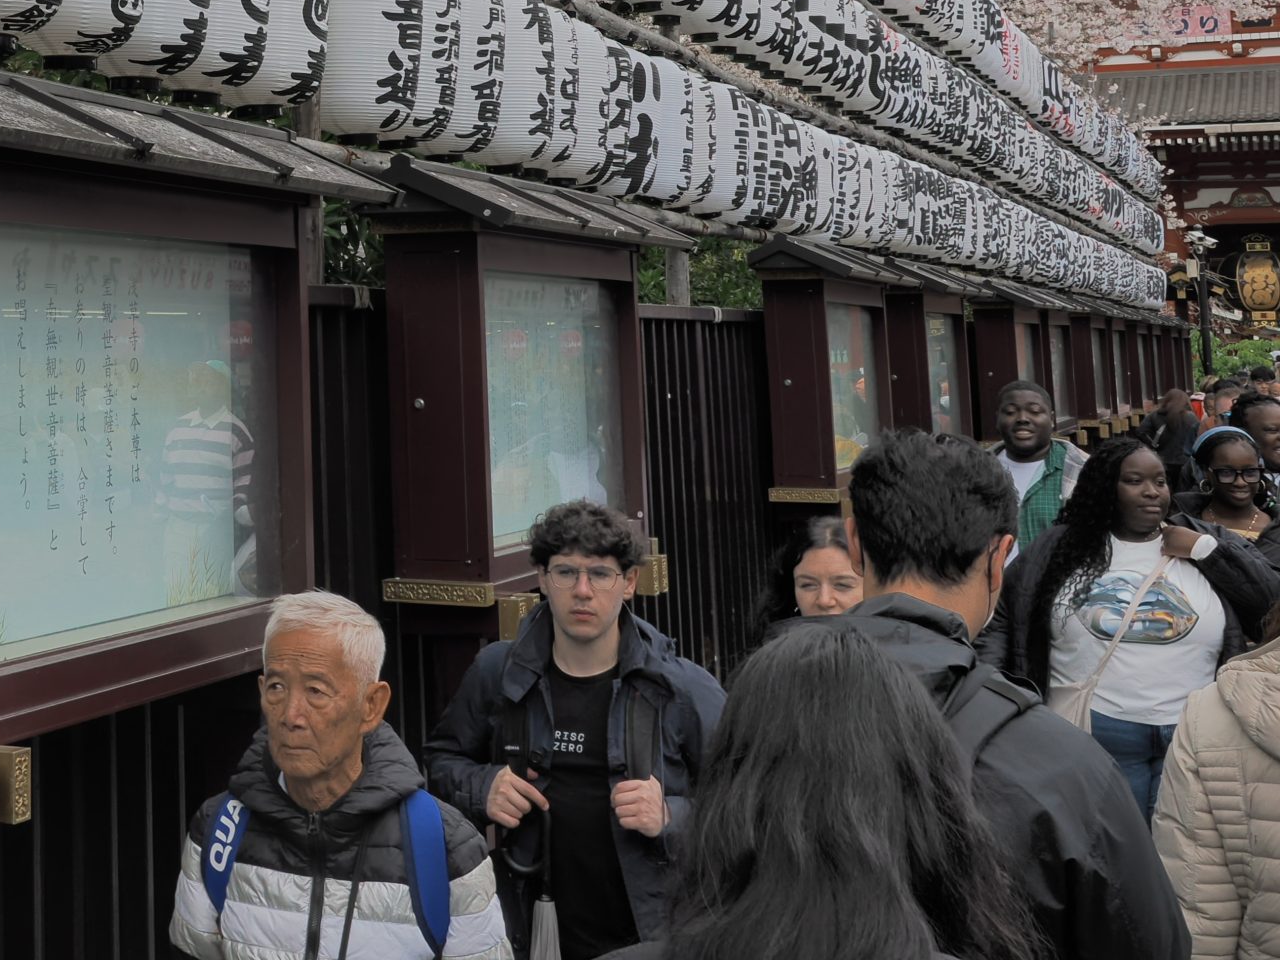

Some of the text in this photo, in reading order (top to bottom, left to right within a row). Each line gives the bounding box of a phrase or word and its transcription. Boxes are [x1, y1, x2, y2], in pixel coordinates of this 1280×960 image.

[127, 275, 142, 485] 浅草寺のご本尊は
[553, 741, 583, 753] ZERO
[554, 730, 585, 742] RISC
[208, 798, 244, 873] QUA
